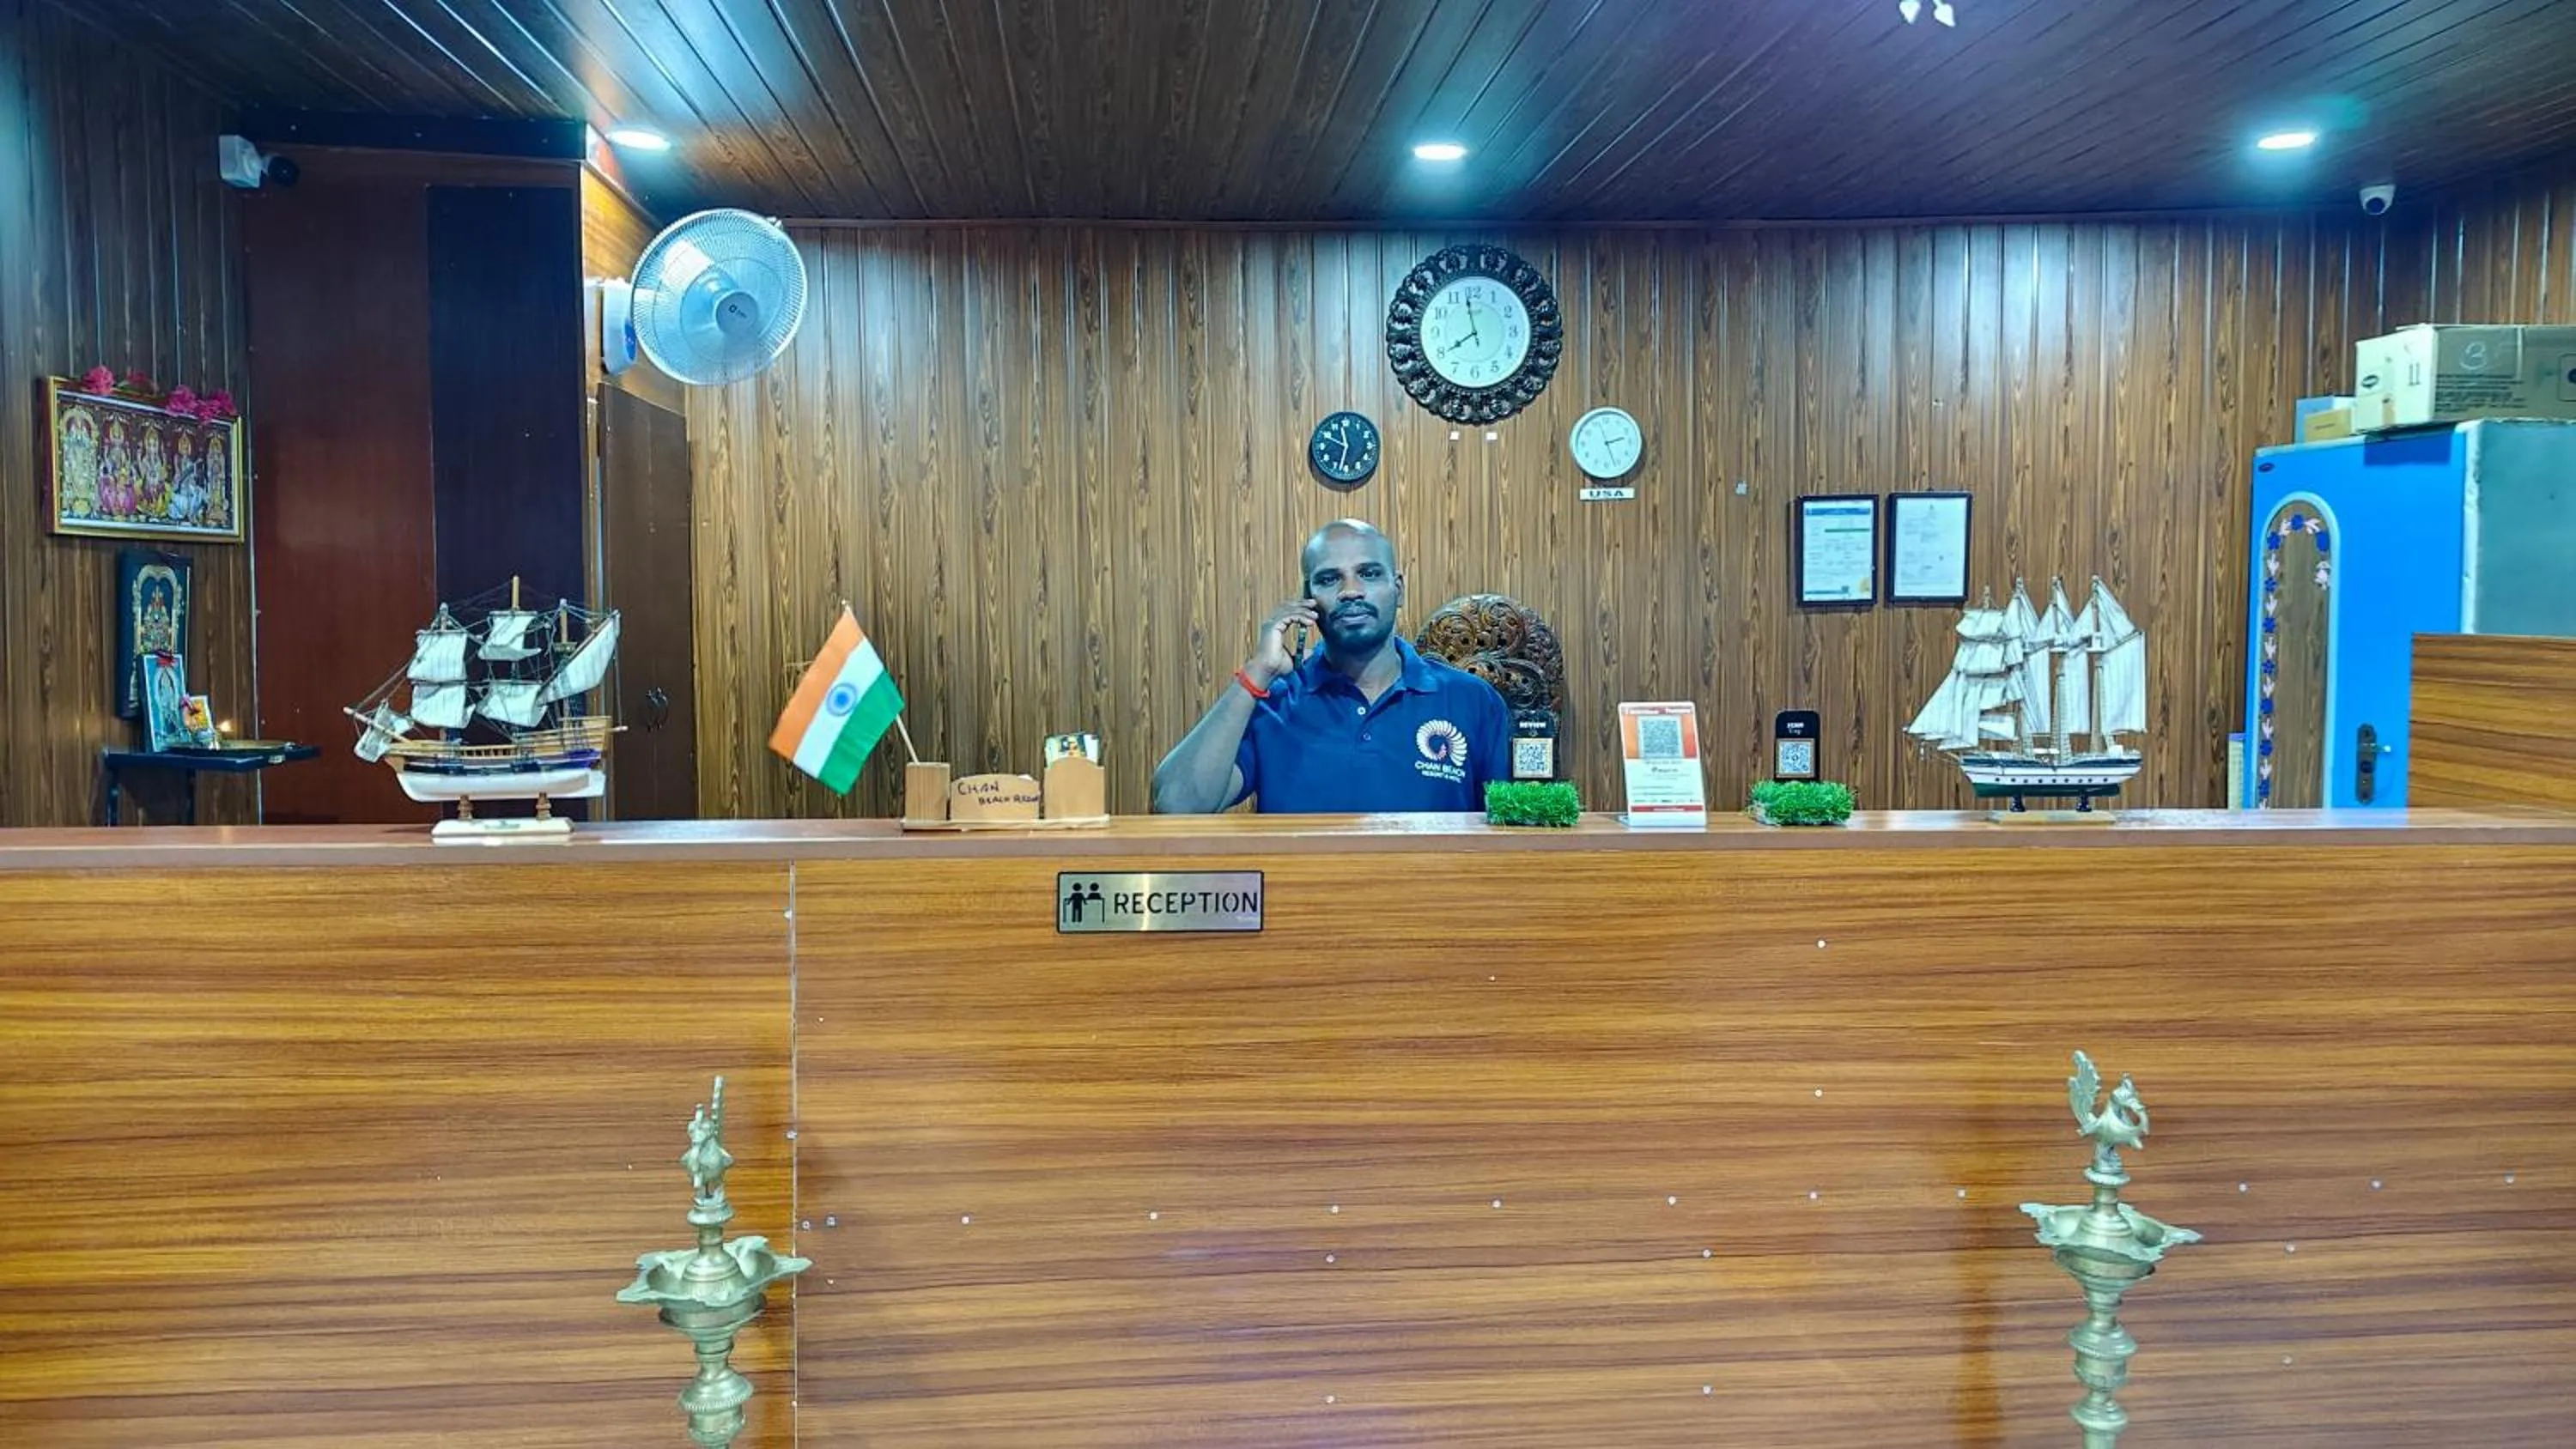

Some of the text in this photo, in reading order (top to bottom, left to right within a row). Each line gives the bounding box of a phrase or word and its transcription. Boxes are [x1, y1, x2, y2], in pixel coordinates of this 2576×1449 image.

[1448, 291, 1460, 305] 11
[1434, 306, 1449, 321] 10
[1504, 305, 1512, 318] 2
[1430, 325, 1441, 339] 9
[1508, 325, 1519, 338] 3
[1437, 346, 1445, 360] 8
[1449, 361, 1460, 375] 7
[1470, 365, 1479, 379] 6
[1414, 760, 1442, 771] CHAN
[957, 780, 999, 796] CHAN
[1113, 891, 1258, 914] RECEPTION
